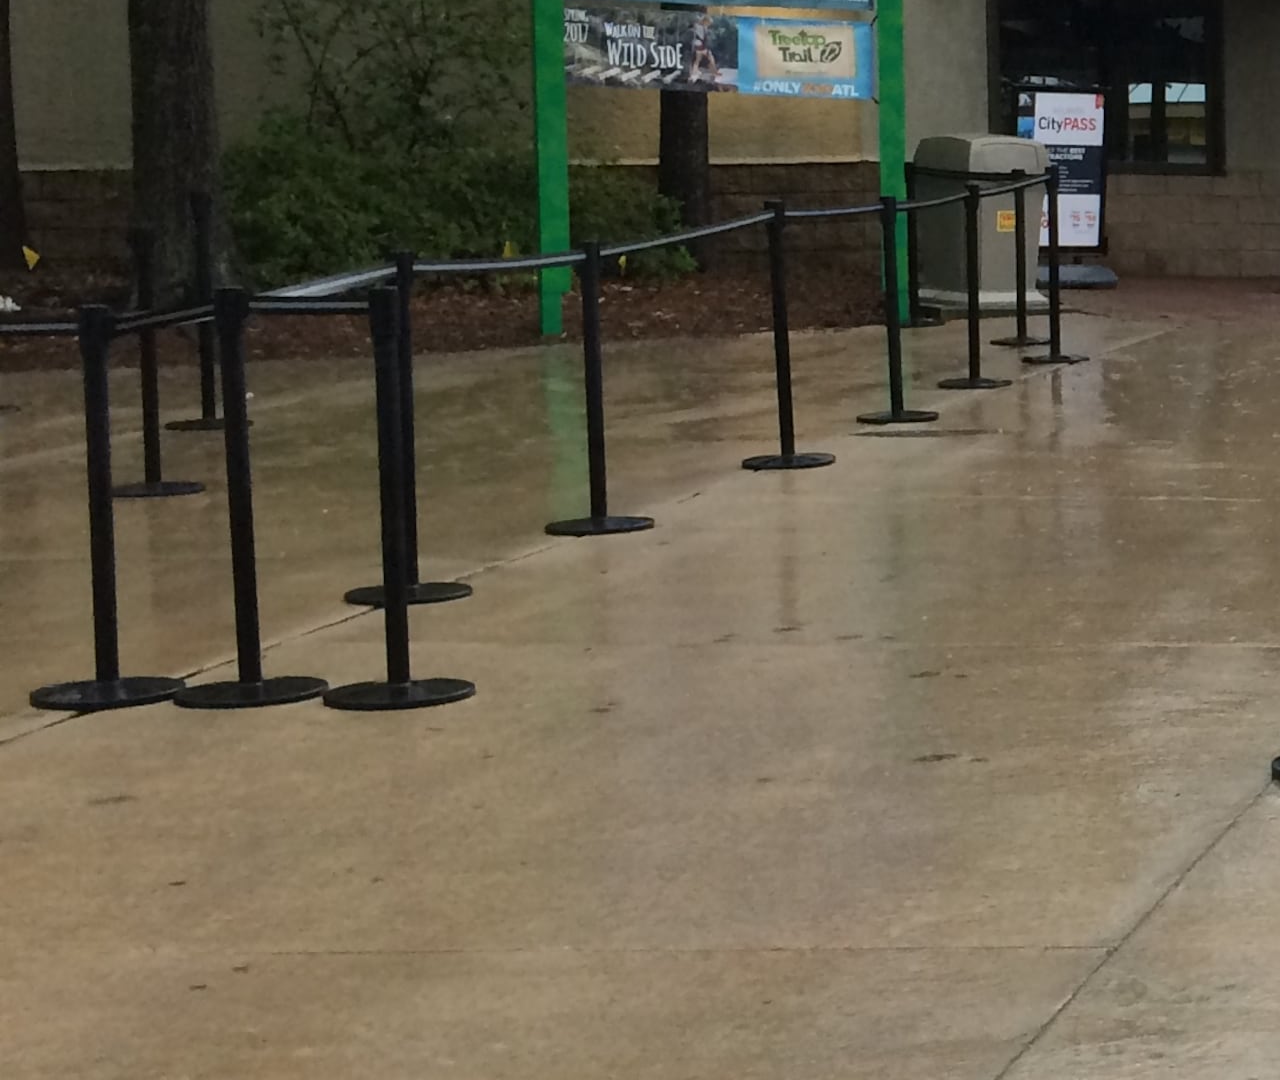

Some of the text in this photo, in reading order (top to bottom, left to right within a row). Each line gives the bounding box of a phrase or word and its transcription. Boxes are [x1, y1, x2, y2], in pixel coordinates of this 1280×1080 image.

[563, 22, 589, 43] 2017
[603, 22, 627, 38] WALK
[627, 23, 641, 38] ON
[768, 29, 826, 49] Treetop
[606, 39, 684, 69] WILD SIDE
[778, 47, 814, 63] Trail
[1038, 116, 1097, 133] CityPASS
